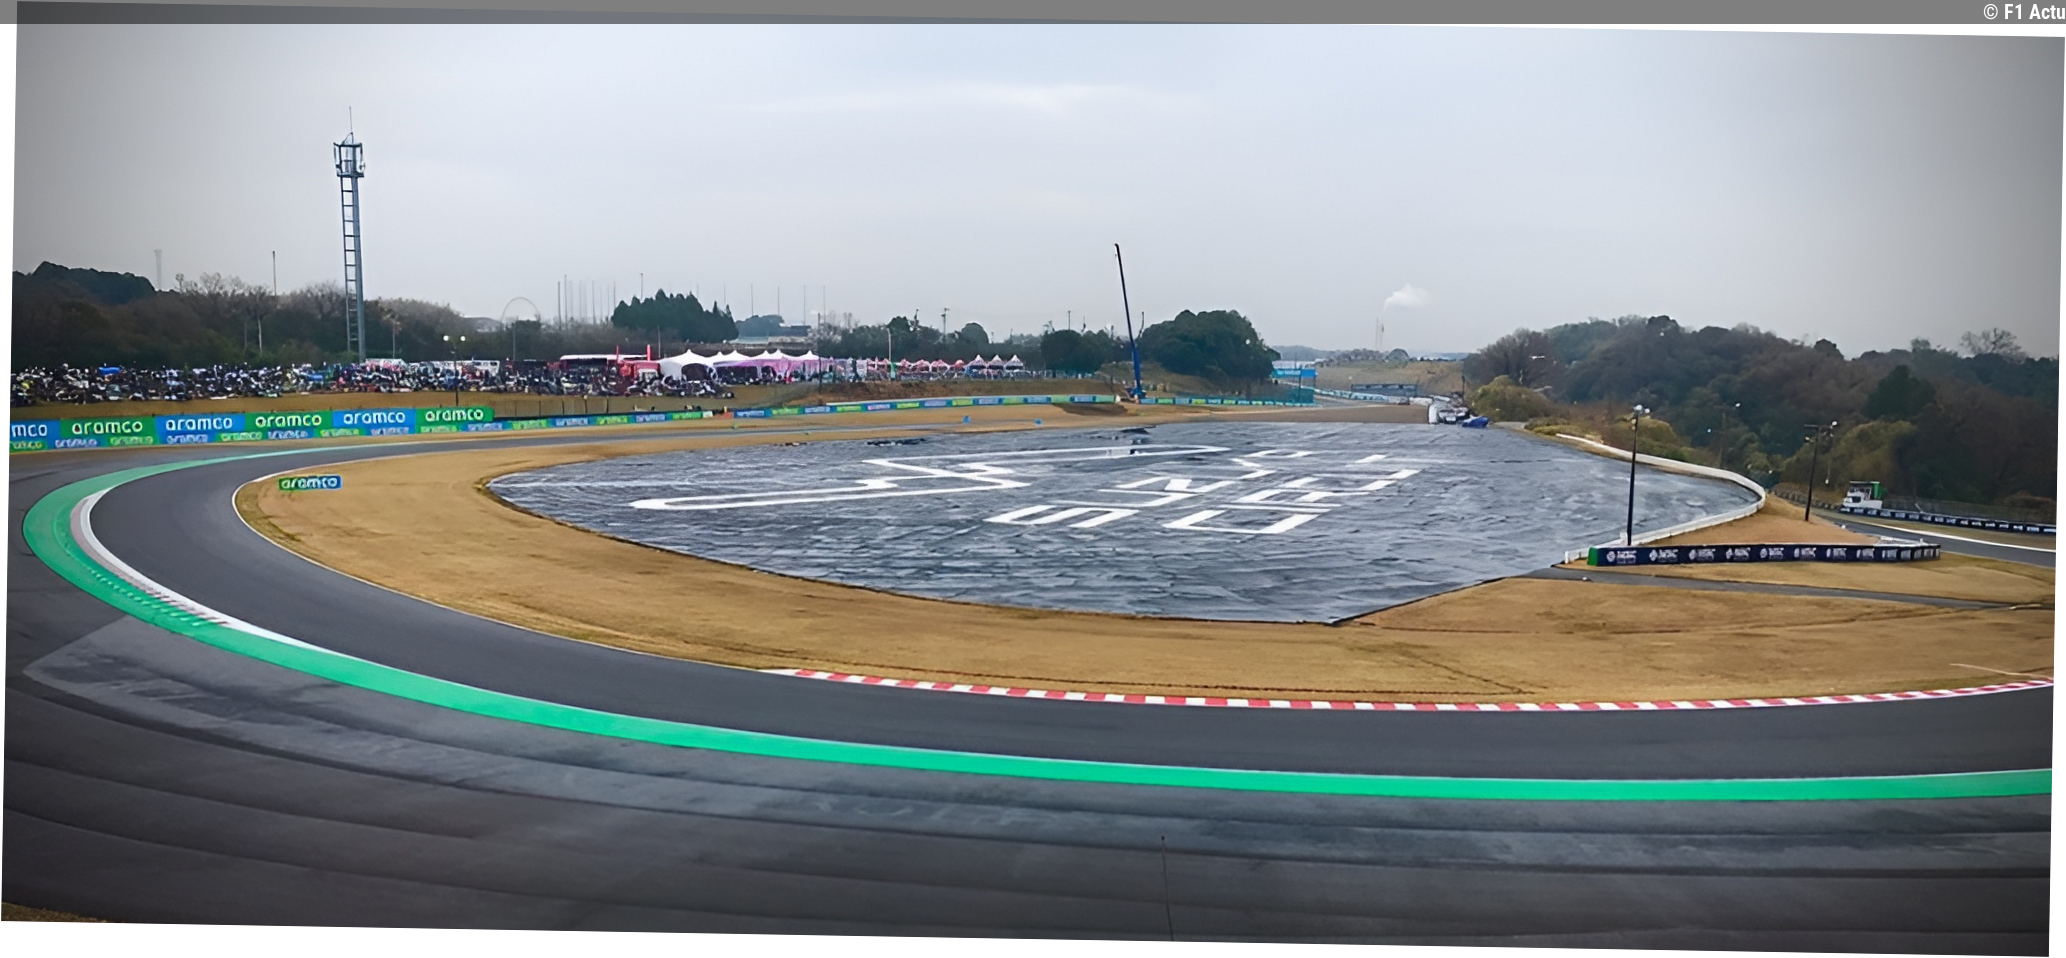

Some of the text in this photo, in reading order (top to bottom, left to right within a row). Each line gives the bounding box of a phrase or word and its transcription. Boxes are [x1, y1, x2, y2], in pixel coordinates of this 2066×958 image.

[255, 414, 322, 428] aramco
[343, 411, 406, 425] aramco
[425, 408, 484, 422] aramco
[71, 420, 143, 435] aramco
[165, 417, 233, 431] aramco
